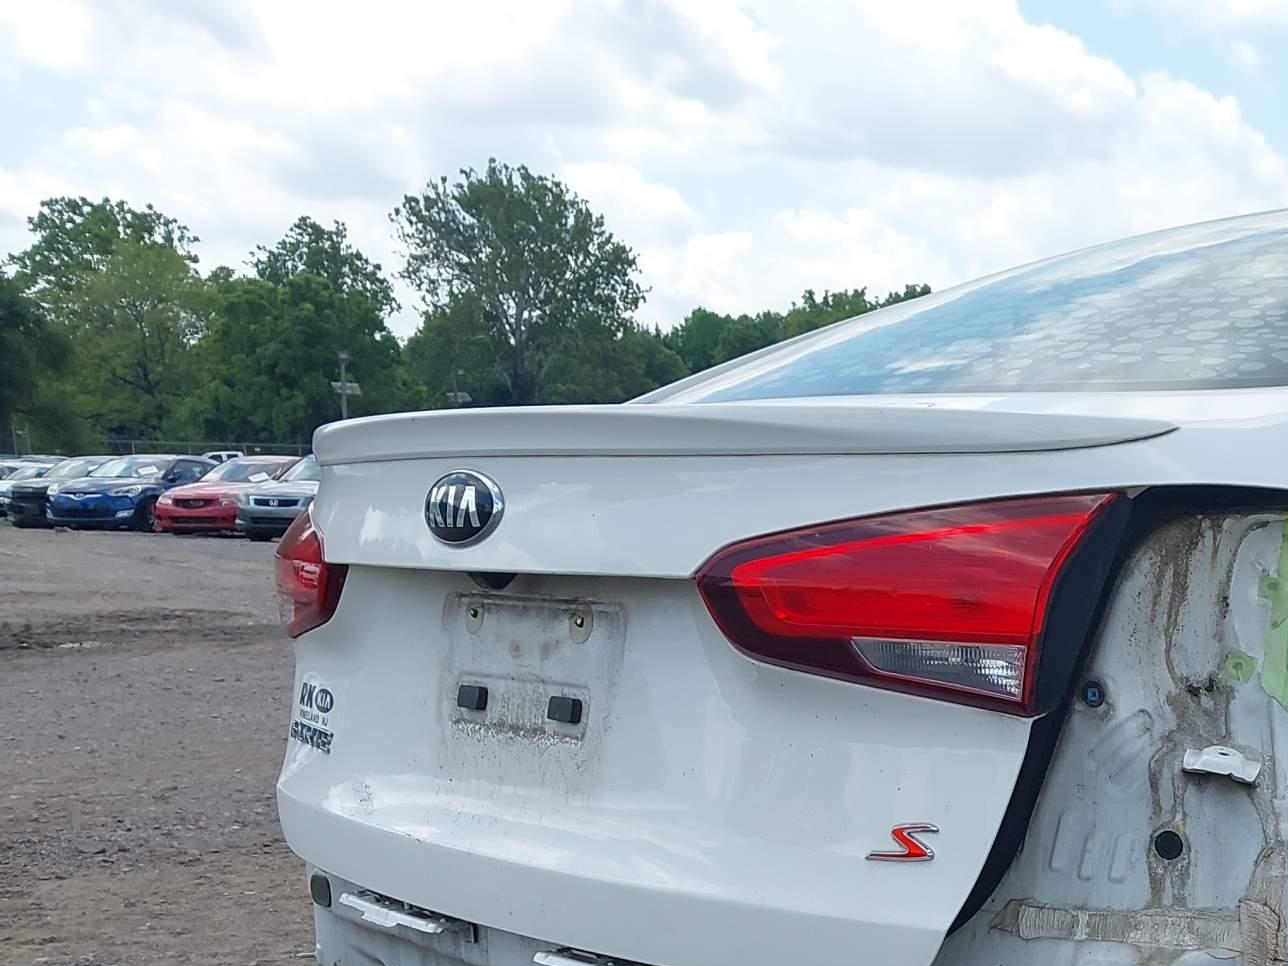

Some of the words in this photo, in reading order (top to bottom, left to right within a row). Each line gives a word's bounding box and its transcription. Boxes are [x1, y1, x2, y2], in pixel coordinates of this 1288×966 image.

[429, 485, 480, 528] KIA
[299, 682, 316, 709] RK
[316, 691, 332, 710] KIA
[864, 822, 940, 863] S
